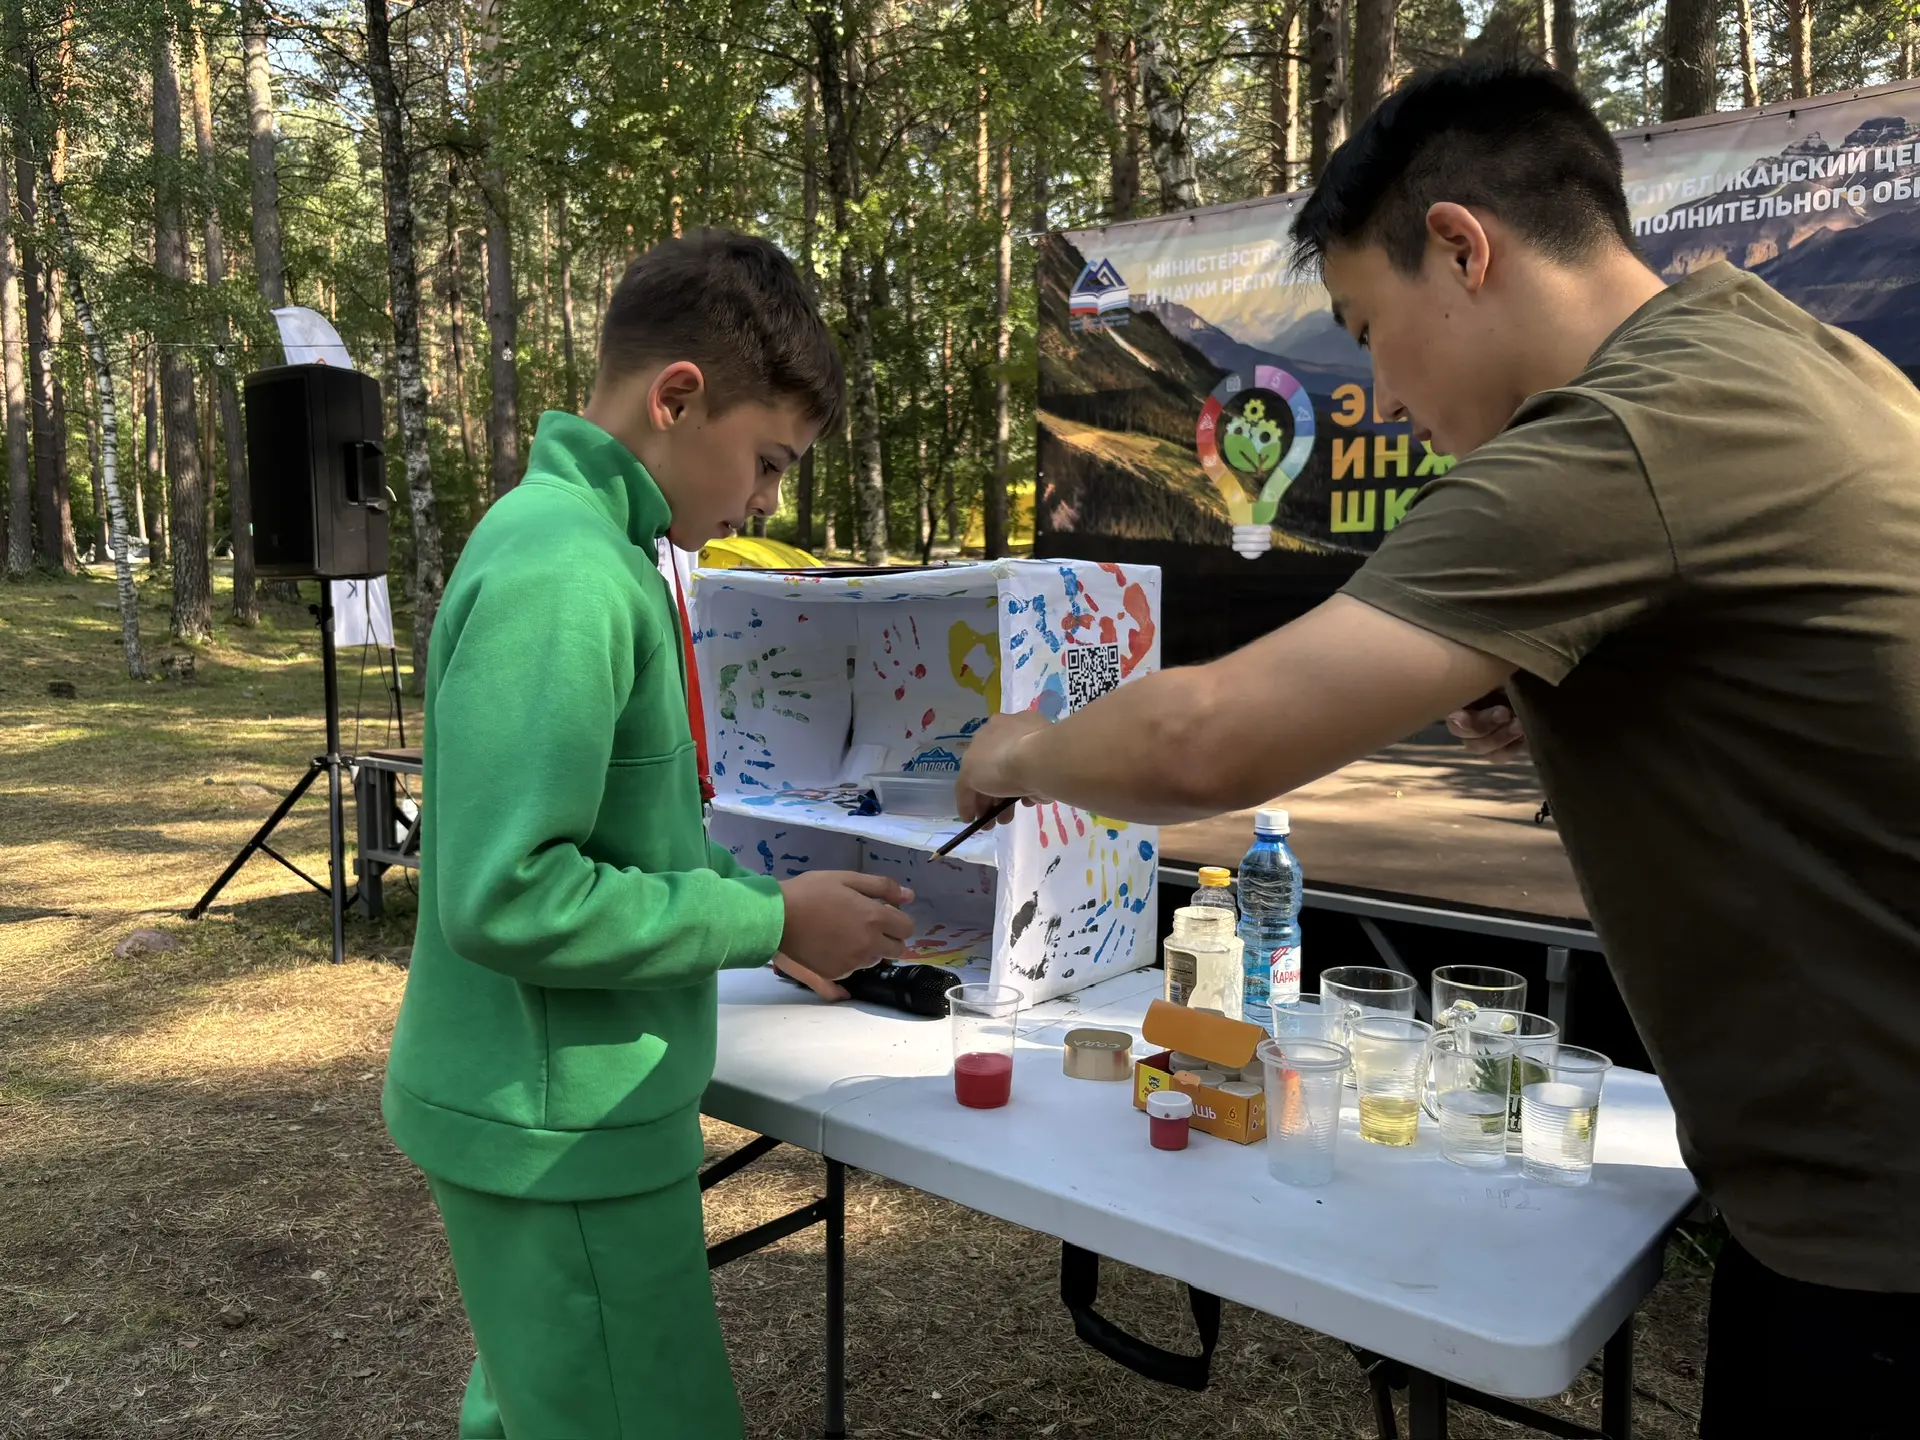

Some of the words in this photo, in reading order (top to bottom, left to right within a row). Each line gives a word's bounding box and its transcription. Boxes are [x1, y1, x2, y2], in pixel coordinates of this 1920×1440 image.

[1624, 146, 1866, 205] СПУБЛИКАНСКИЙ
[1631, 184, 1866, 237] ПОЛНИТЕЛЬНОГО
[1146, 288, 1157, 306] И
[1160, 280, 1218, 304] НАУКИ
[1228, 1106, 1238, 1120] 6
